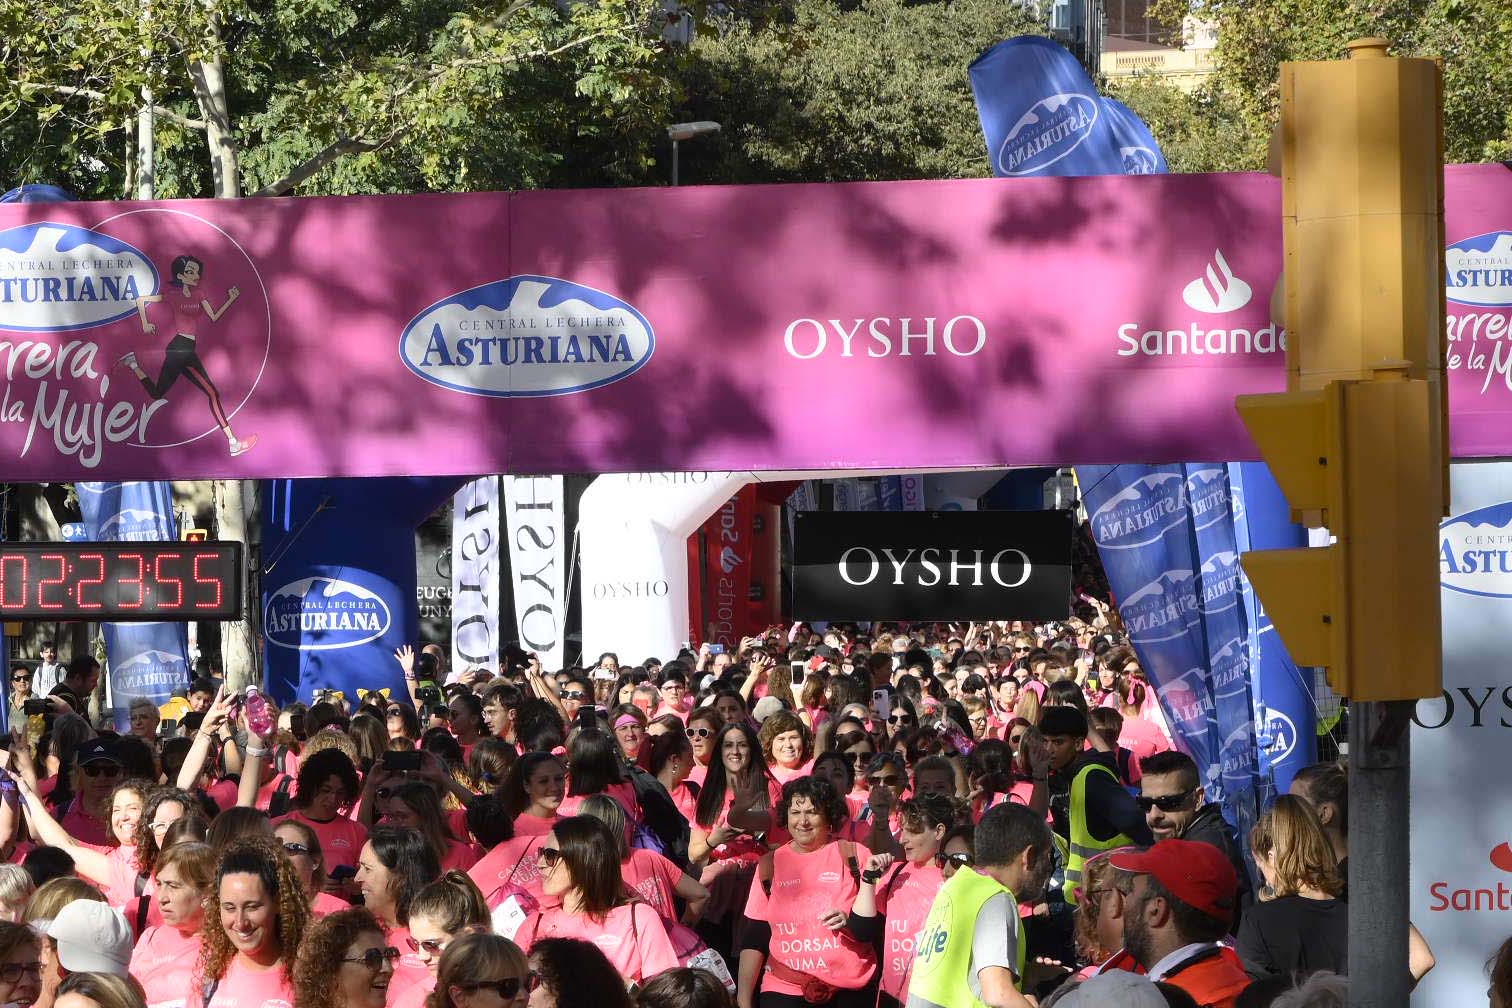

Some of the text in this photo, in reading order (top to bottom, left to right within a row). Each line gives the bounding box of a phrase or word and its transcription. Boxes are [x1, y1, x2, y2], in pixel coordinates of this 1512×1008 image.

[62, 258, 134, 270] LECHERA
[459, 316, 626, 332] CENTRAL LECHERA
[783, 314, 987, 360] OYSHO
[419, 321, 635, 368] ASTURIANA
[1467, 341, 1486, 370] la
[0, 383, 25, 423] la
[20, 375, 168, 469] Mujer
[838, 546, 1033, 588] OYSHO
[0, 554, 222, 609] 02:23:55
[592, 579, 670, 600] OYSHO
[269, 607, 381, 633] ASTURIANA
[1429, 882, 1512, 912] Sant
[776, 922, 795, 935] TU
[891, 920, 907, 933] TU
[781, 937, 840, 953] DORSAL
